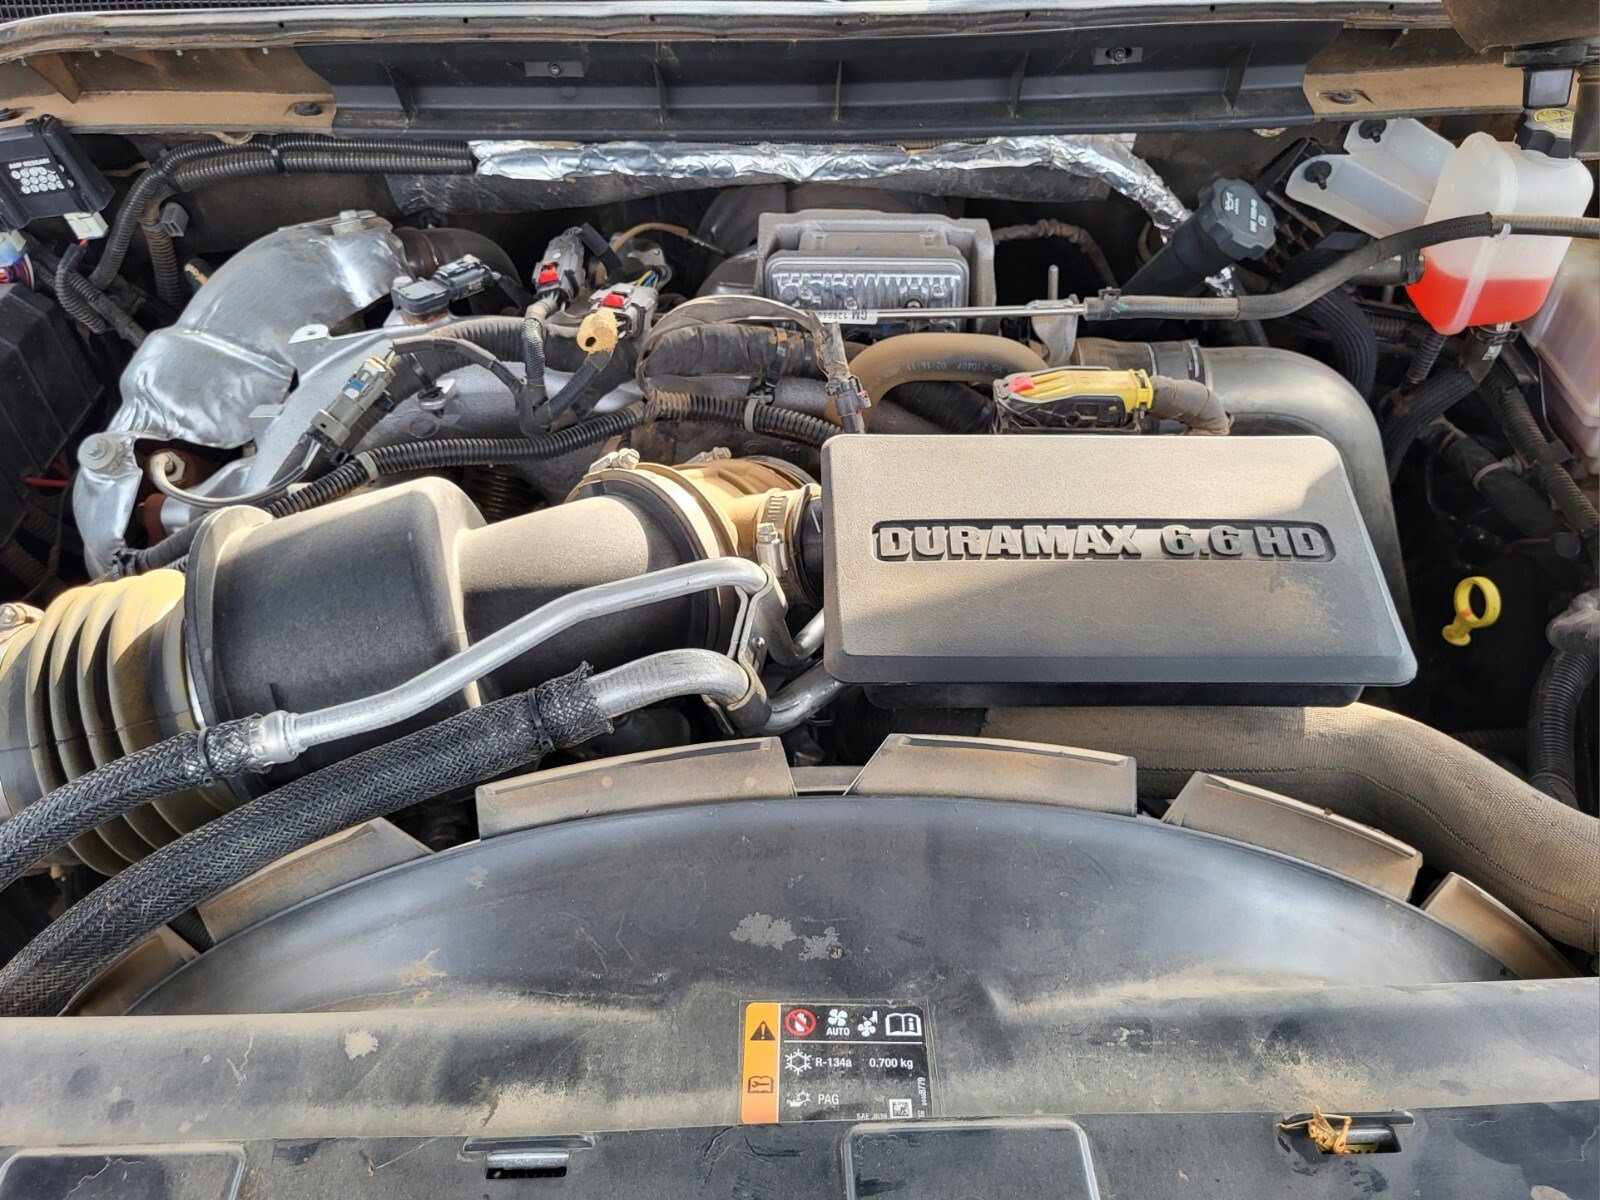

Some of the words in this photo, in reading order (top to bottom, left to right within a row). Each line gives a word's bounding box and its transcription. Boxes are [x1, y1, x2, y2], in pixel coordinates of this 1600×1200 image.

[852, 310, 867, 321] GM
[877, 524, 1141, 560] DURAMAX
[1161, 524, 1244, 560] 6.6
[1254, 525, 1327, 561] HD
[826, 1027, 850, 1036] AUTO
[815, 1058, 852, 1068] R-134a
[869, 1058, 898, 1068] 0.700
[900, 1058, 914, 1070] kg
[818, 1094, 840, 1105] PAG
[856, 1112, 870, 1120] SAE
